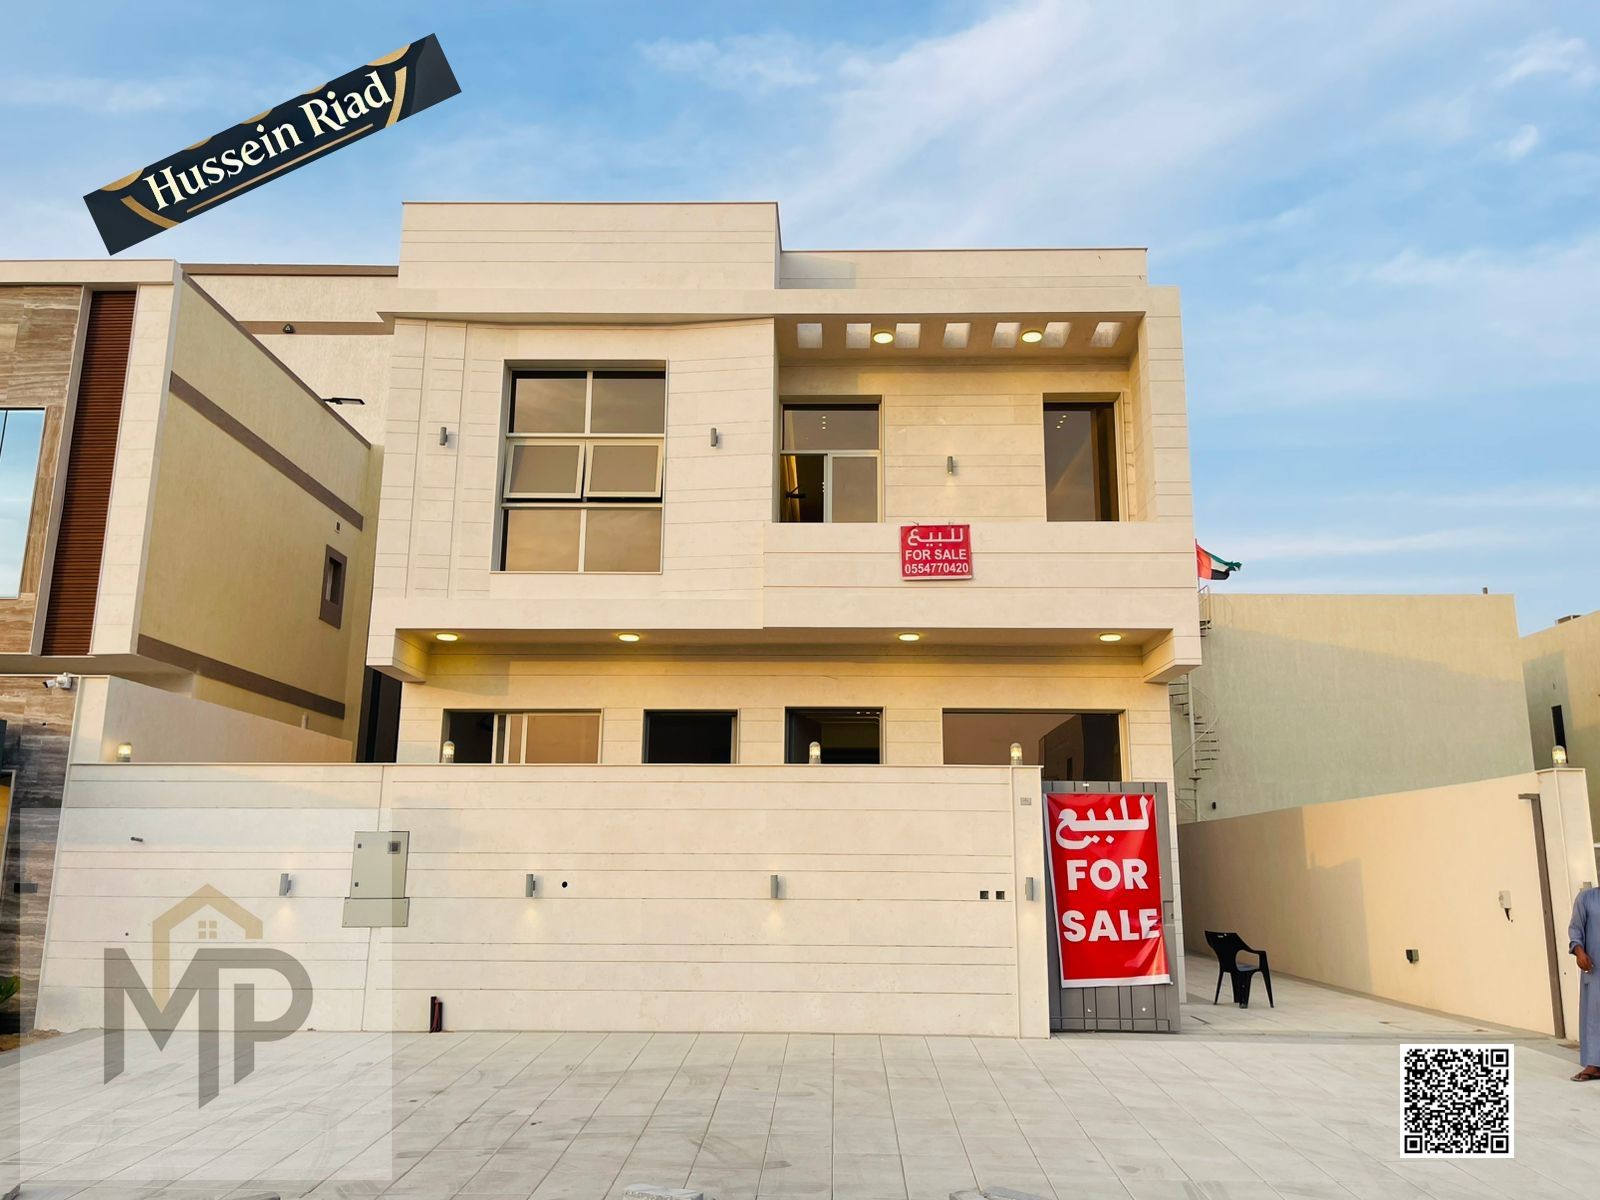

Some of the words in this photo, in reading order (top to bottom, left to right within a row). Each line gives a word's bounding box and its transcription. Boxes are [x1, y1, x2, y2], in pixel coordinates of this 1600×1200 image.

[907, 527, 964, 547] للبيع
[904, 562, 969, 574] 0554770420
[905, 549, 931, 561] FOR
[934, 549, 967, 560] SALE
[1055, 795, 1149, 850] للبيع
[1066, 858, 1149, 891] FOR
[1061, 908, 1161, 943] SALE
